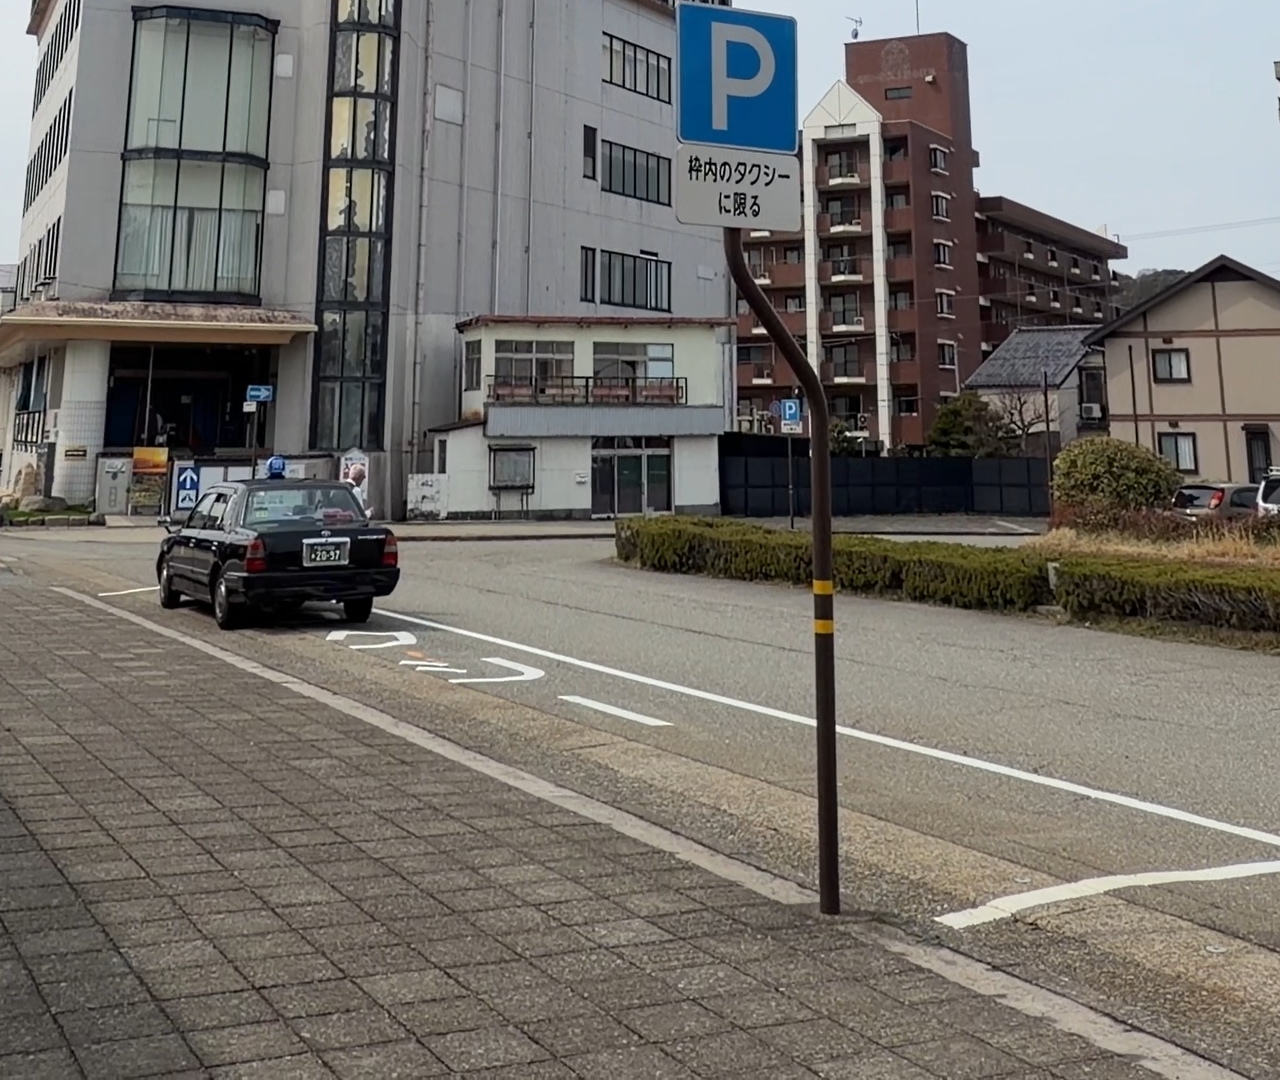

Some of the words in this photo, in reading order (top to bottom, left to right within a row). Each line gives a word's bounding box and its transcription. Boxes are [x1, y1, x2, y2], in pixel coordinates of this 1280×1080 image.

[711, 21, 776, 131] P
[687, 154, 791, 188] 枠内のタクシー
[718, 191, 762, 218] に限る
[785, 402, 795, 419] P
